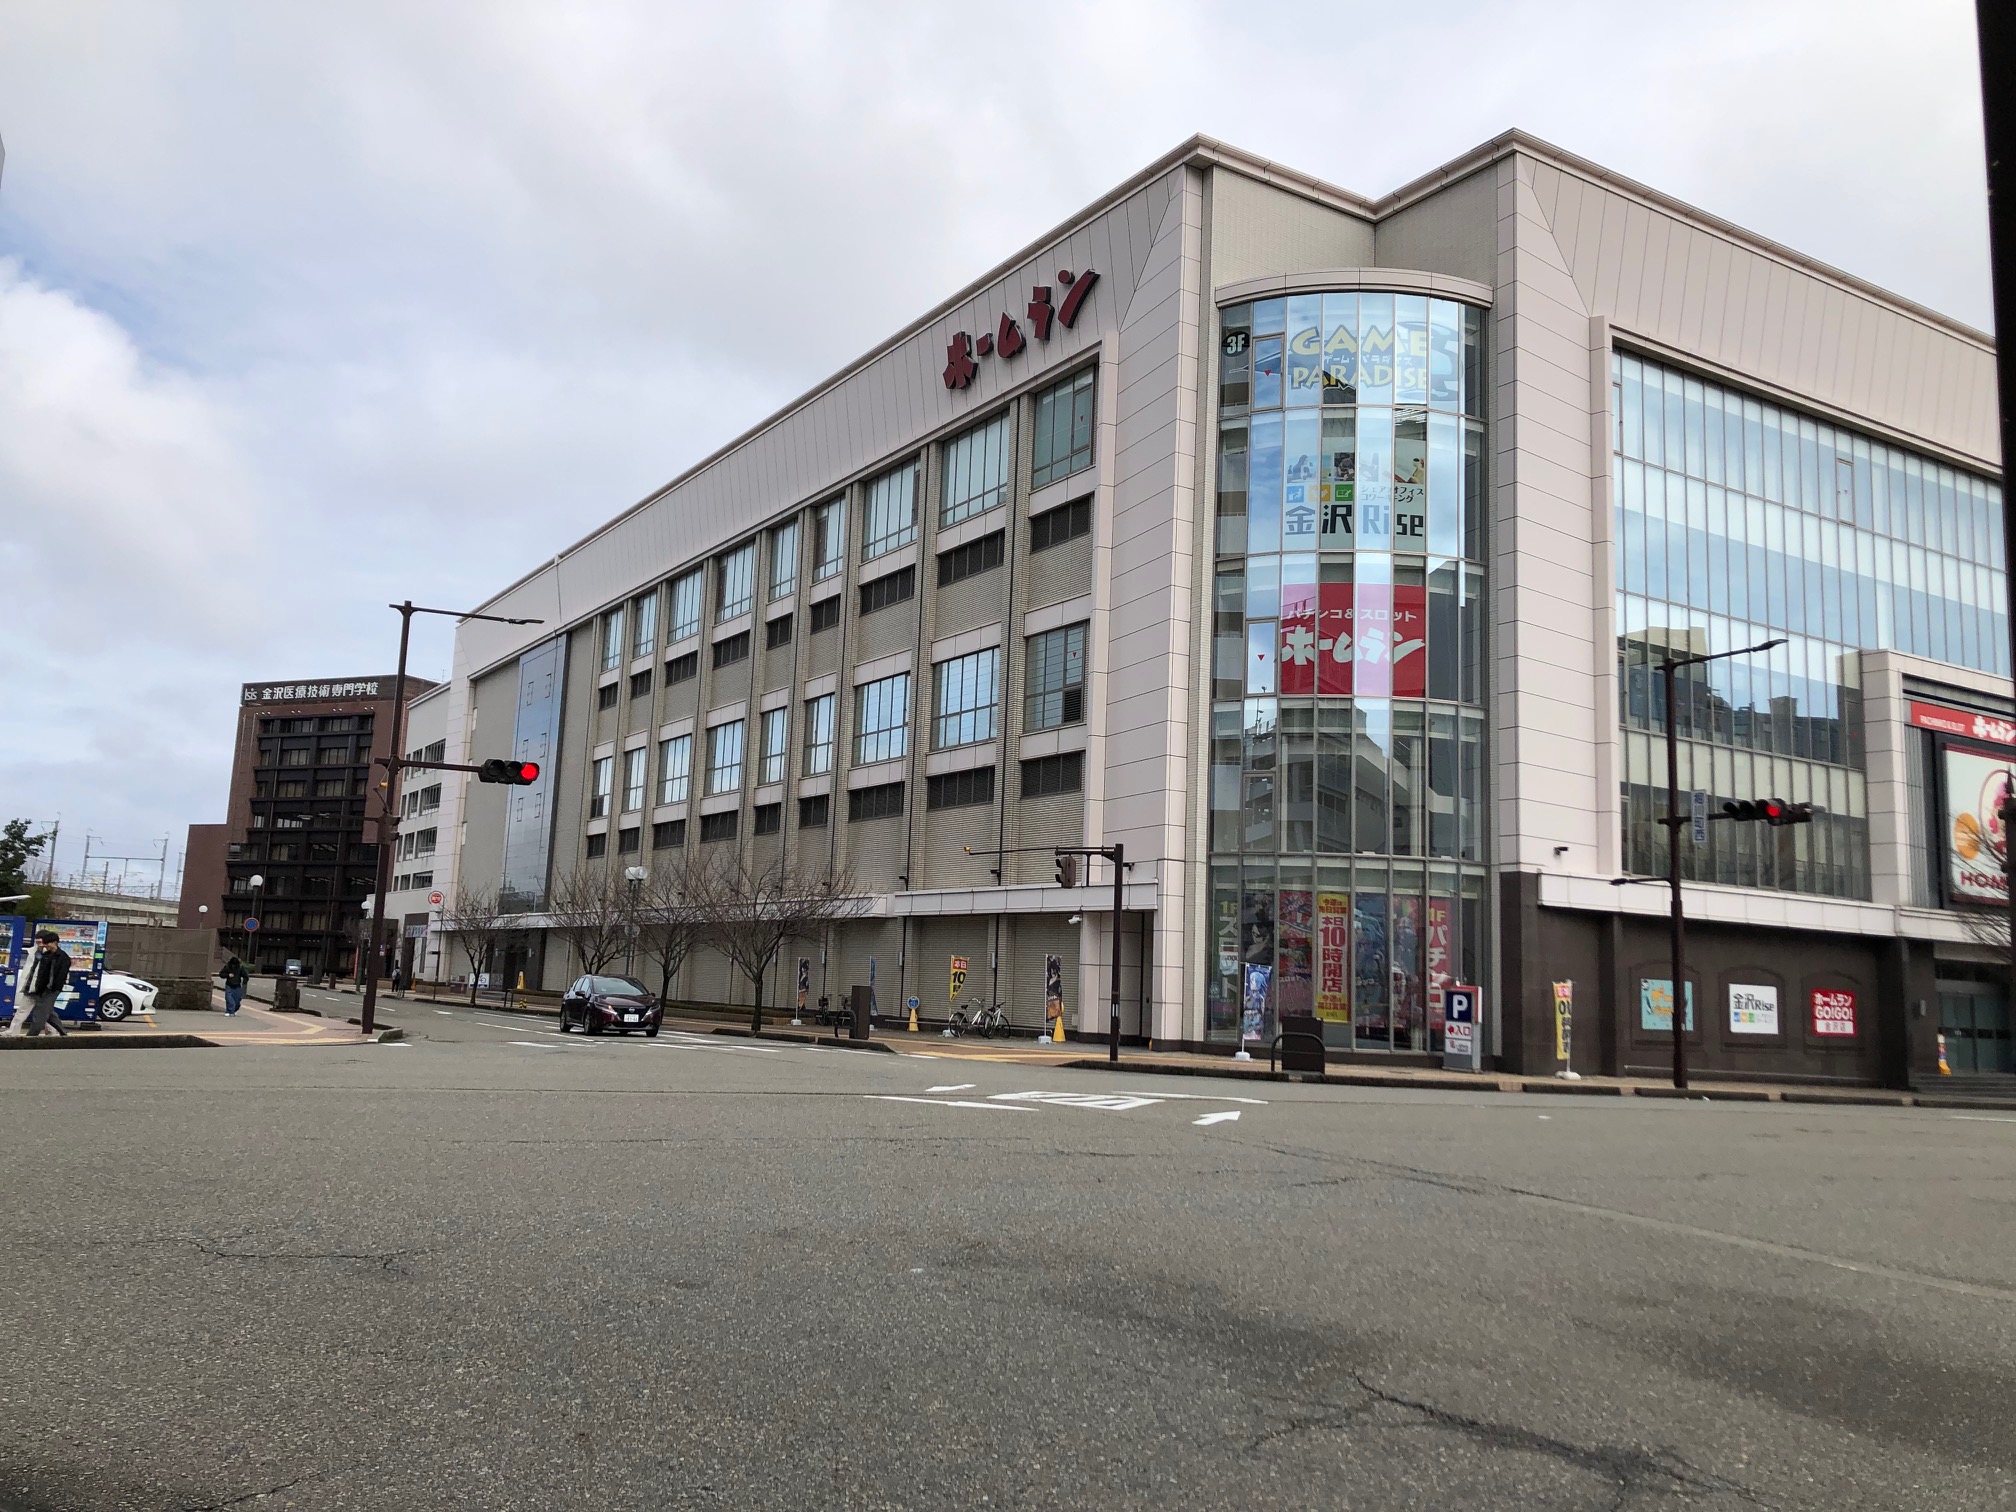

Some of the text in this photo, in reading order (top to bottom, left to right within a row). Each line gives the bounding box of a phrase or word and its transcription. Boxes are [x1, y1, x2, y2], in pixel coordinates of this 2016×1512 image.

[943, 268, 1101, 389] ホームラン
[1226, 334, 1245, 355] 3F
[1291, 326, 1427, 356] GAME
[1292, 365, 1427, 389] PARADISE
[1281, 625, 1425, 665] ホームラン
[261, 682, 379, 700] 金沢医療技術専門学校
[1322, 916, 1343, 926] 本日
[1452, 994, 1468, 1019] P
[1814, 993, 1852, 1006] ホームラン
[1815, 1006, 1853, 1020] GO!GO!
